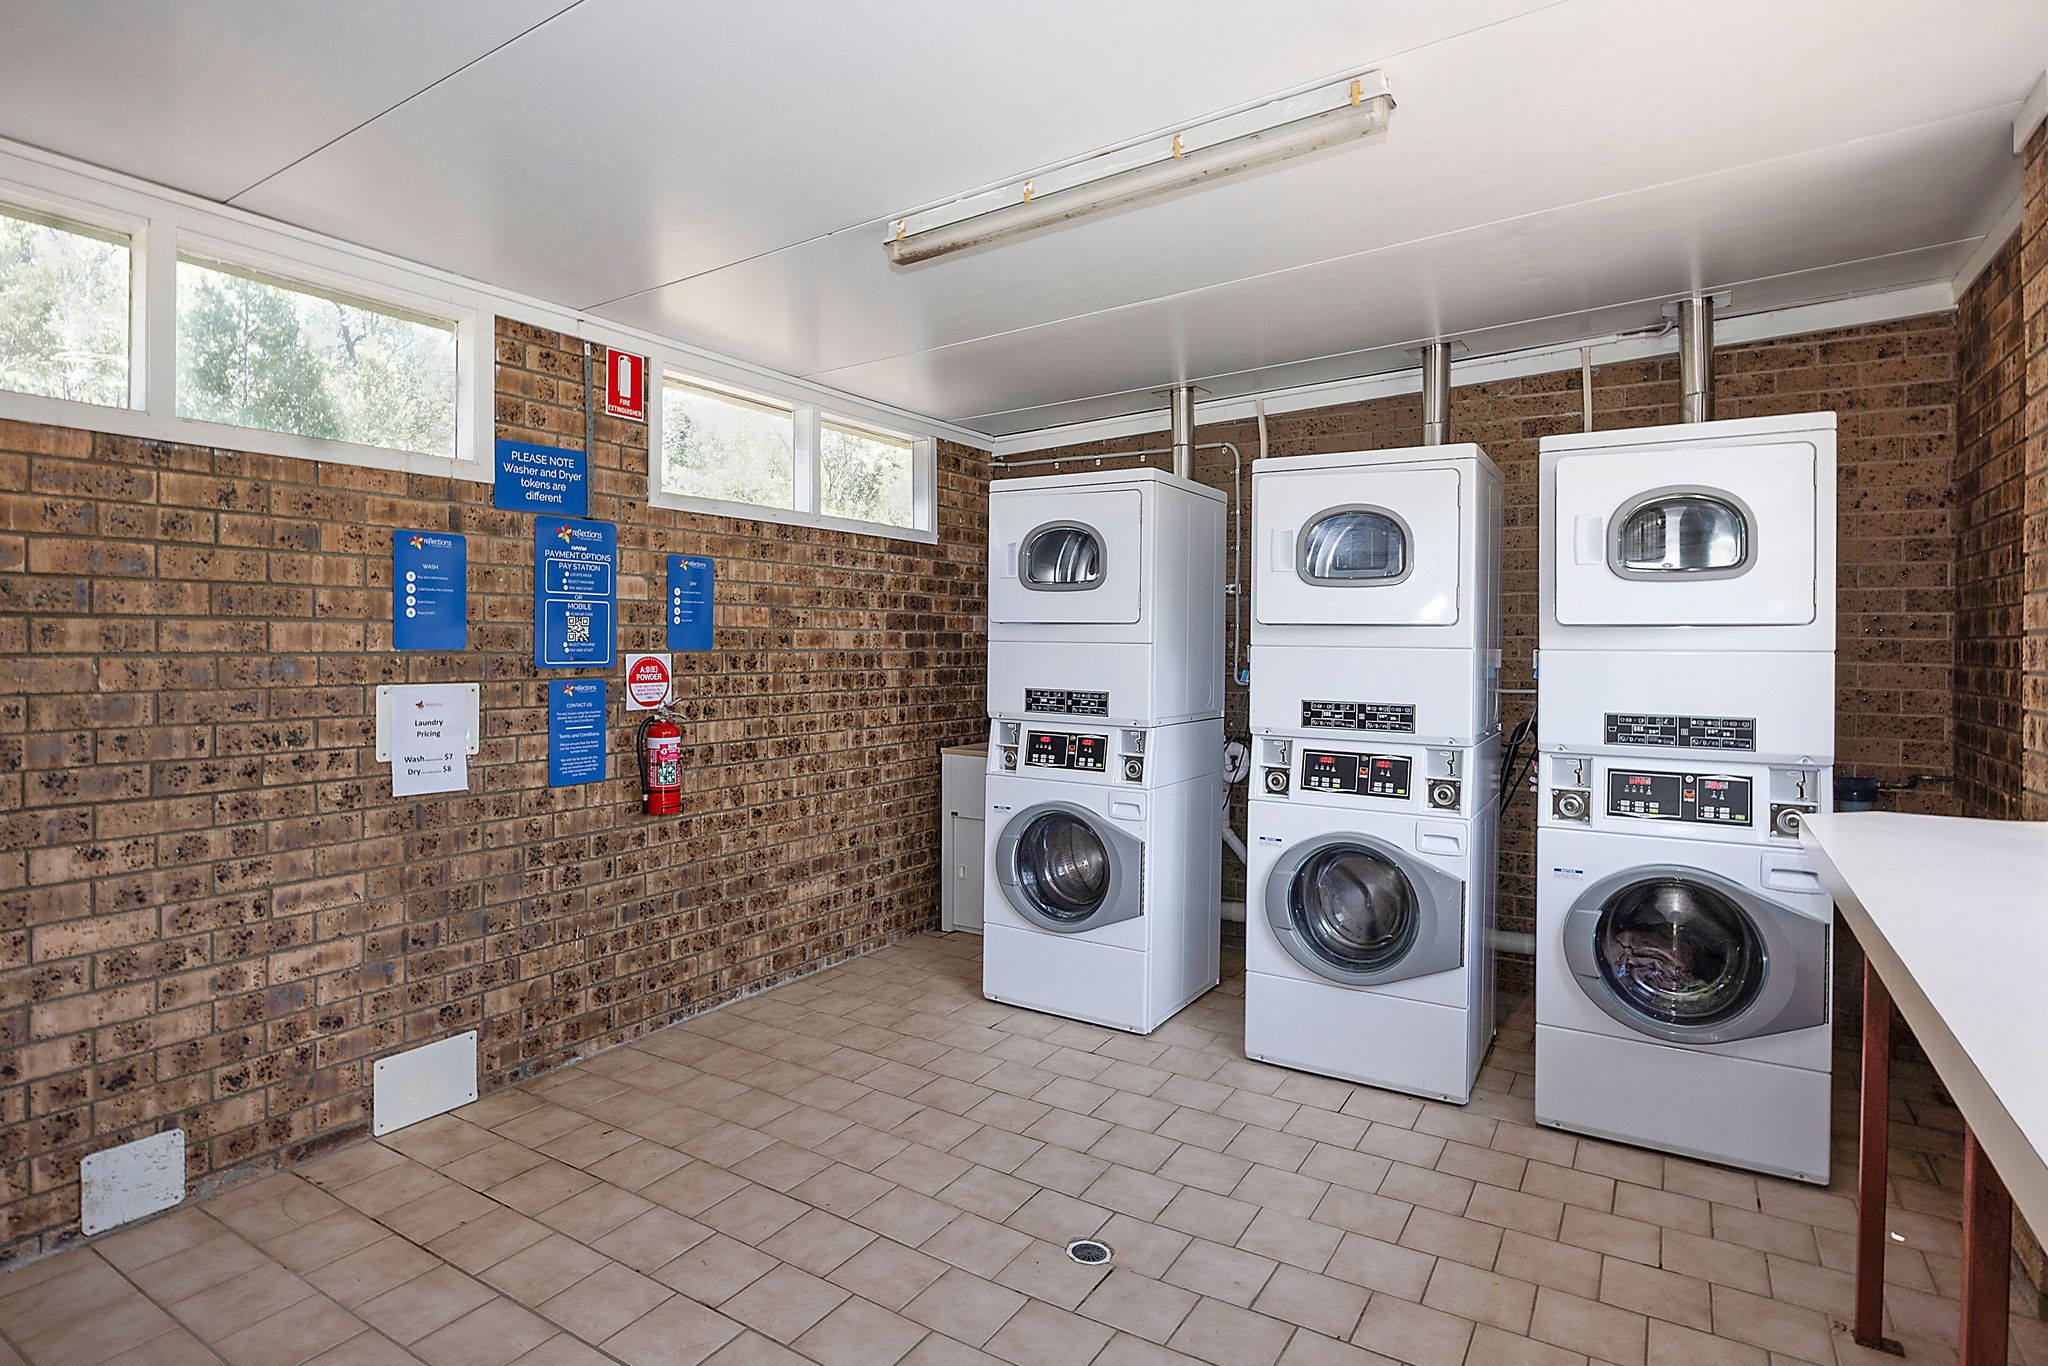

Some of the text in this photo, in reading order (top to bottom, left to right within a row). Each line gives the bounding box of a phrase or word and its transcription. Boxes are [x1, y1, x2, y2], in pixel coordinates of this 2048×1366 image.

[620, 398, 630, 406] FIRE
[608, 404, 641, 417] EXTINGUISHER
[511, 450, 574, 469] PLEASE NOTE
[503, 462, 582, 483] Washer and Dryer
[521, 477, 567, 492] tokens are
[525, 490, 562, 504] different
[572, 528, 603, 539] reflections
[423, 537, 452, 547] reflections
[544, 549, 611, 562] PAYMENT OPTIONS
[558, 562, 601, 572] PAY STATION
[567, 602, 592, 611] MOBILE
[636, 673, 662, 681] POWDER
[574, 684, 597, 692] reflections
[414, 719, 444, 727] Laundry
[416, 730, 441, 738] Pricing
[444, 753, 453, 761] $7
[1320, 756, 1333, 764] 100
[1377, 760, 1390, 768] 100
[442, 765, 452, 773] $8
